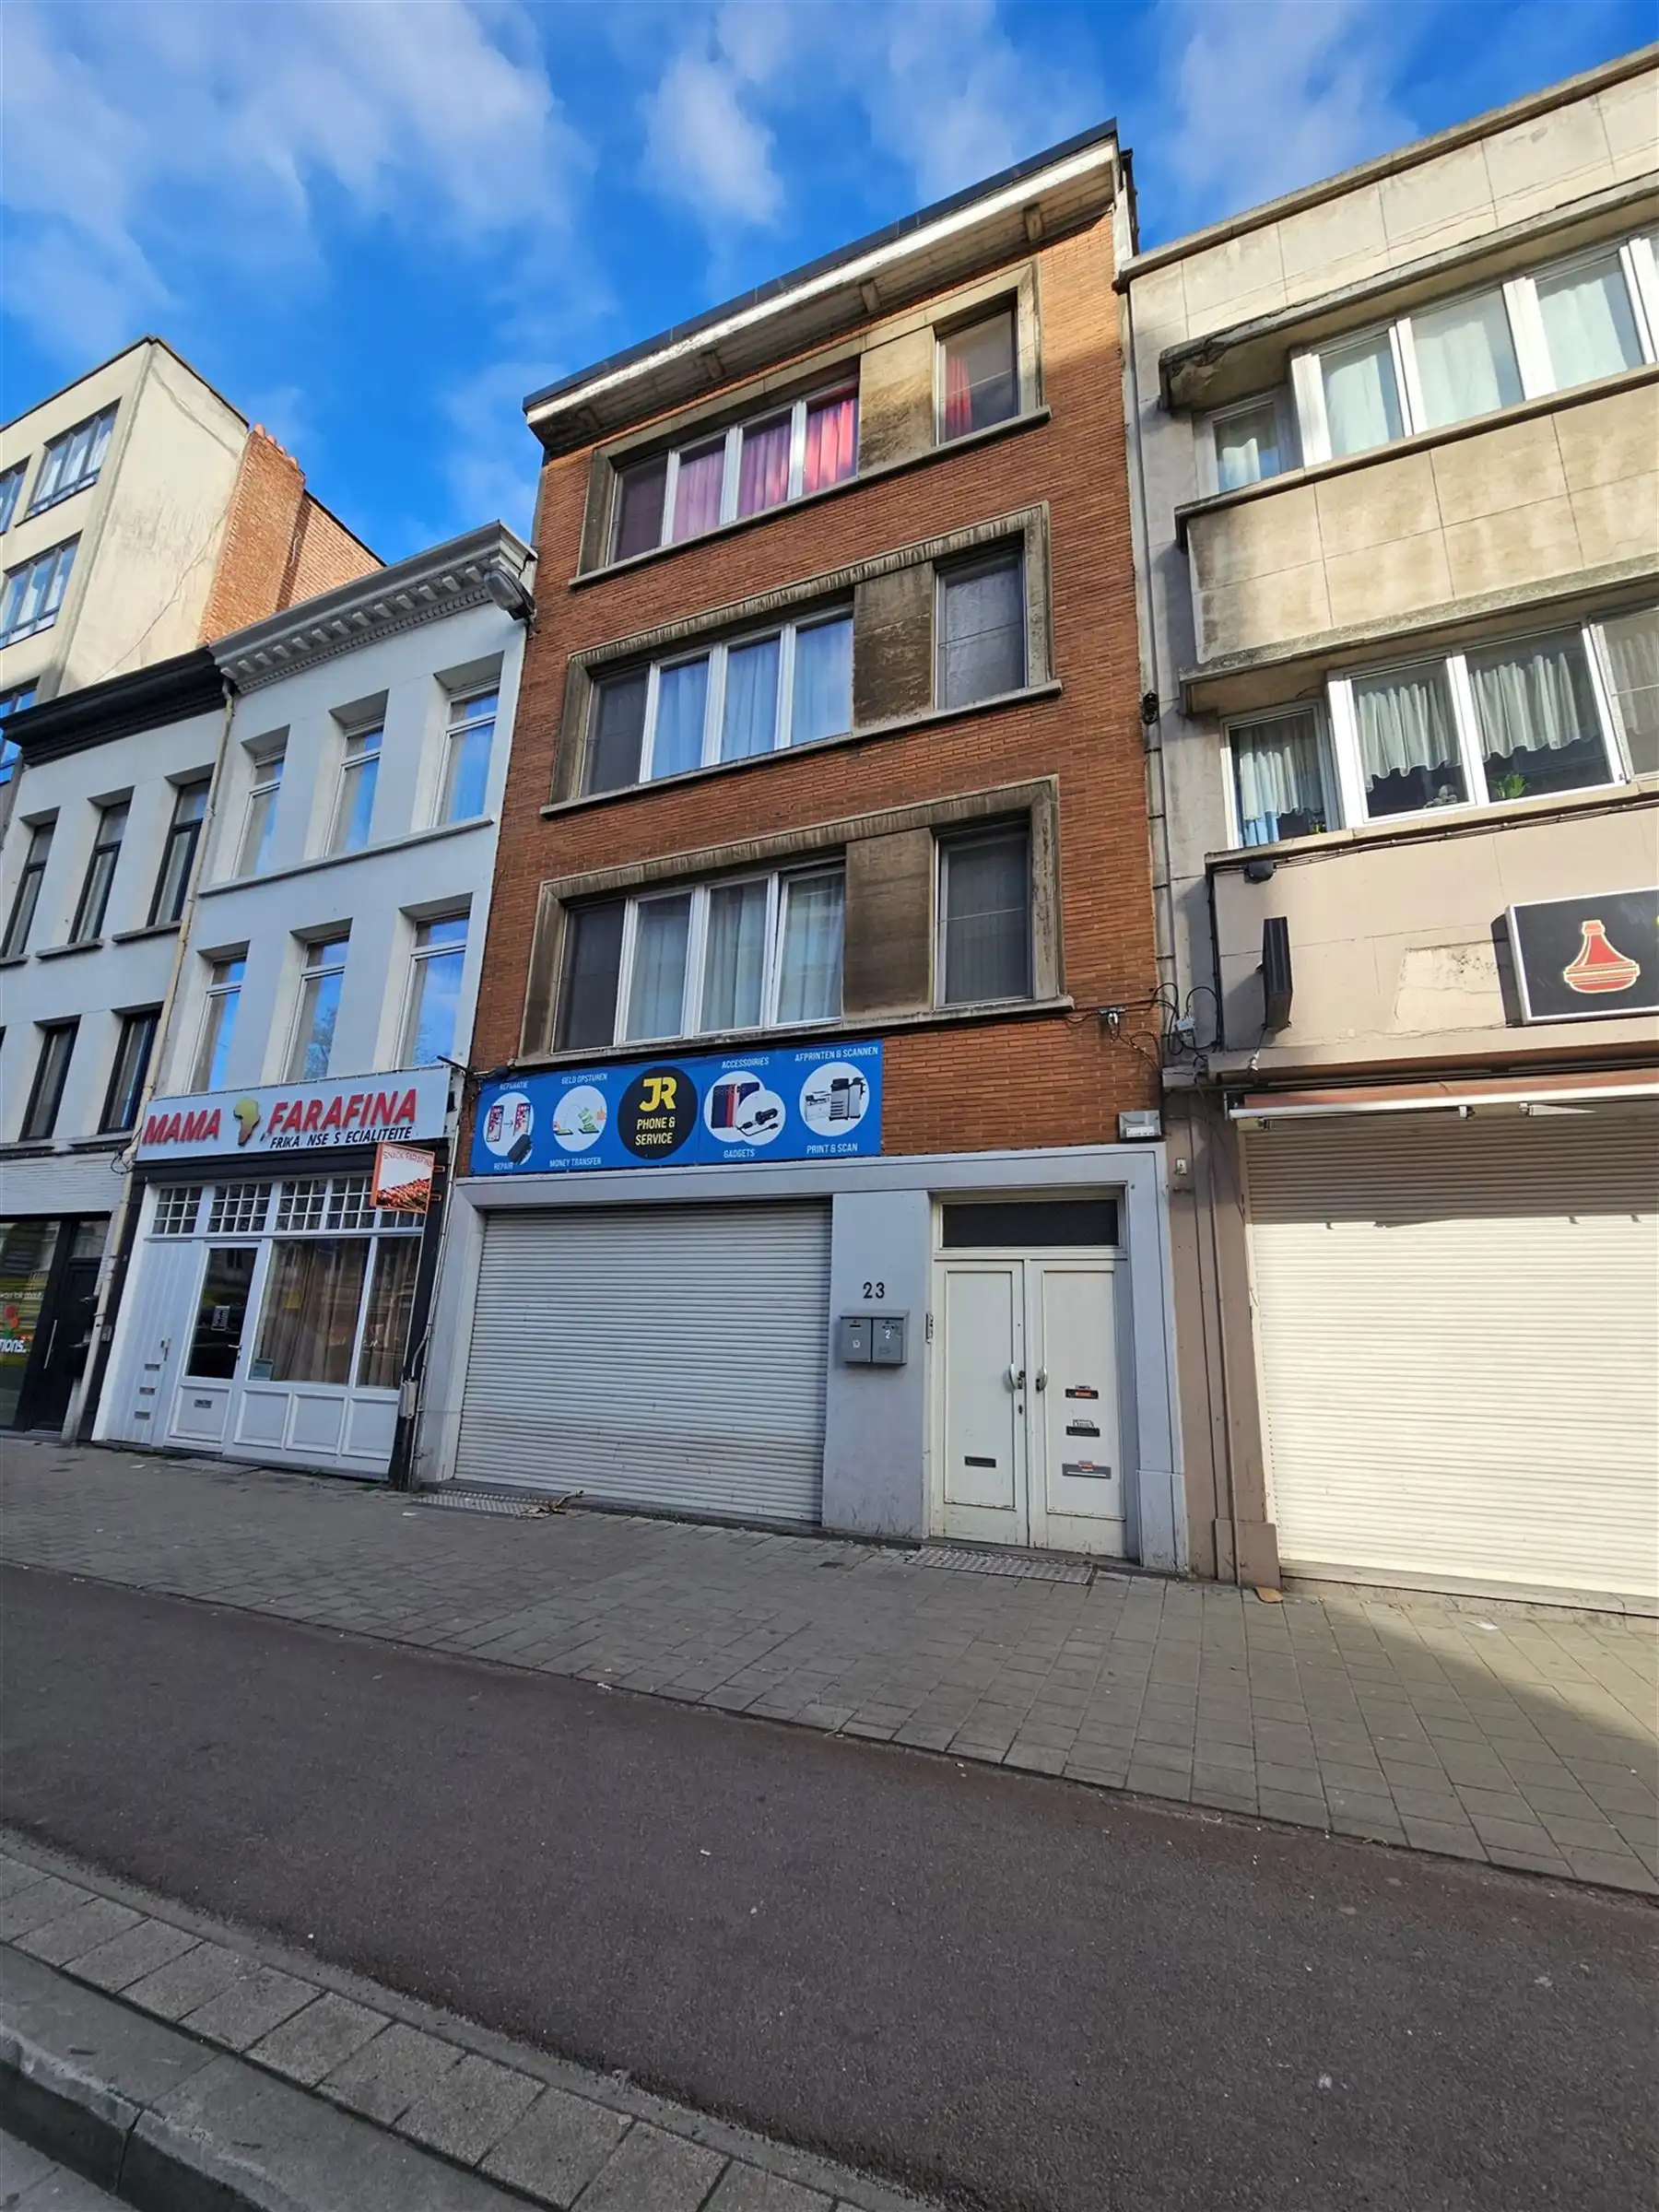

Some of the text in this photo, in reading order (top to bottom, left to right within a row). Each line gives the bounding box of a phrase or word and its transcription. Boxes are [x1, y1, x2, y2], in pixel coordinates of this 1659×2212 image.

[794, 1051, 835, 1062] AFPRINTEN
[842, 1047, 878, 1057] SCANNEN
[561, 1075, 577, 1085] GELD
[639, 1077, 677, 1112] JR
[142, 1088, 417, 1145] MAMA FARAFINA
[637, 1116, 676, 1130] PHONE &
[635, 1132, 673, 1146] SERVICE
[724, 1148, 755, 1159] GADGETS
[806, 1144, 830, 1154] PRINT
[837, 1143, 858, 1152] SCAN
[494, 1161, 513, 1171] REPAIR
[549, 1157, 601, 1168] MONEY TRANSFER
[863, 1281, 885, 1299] 23
